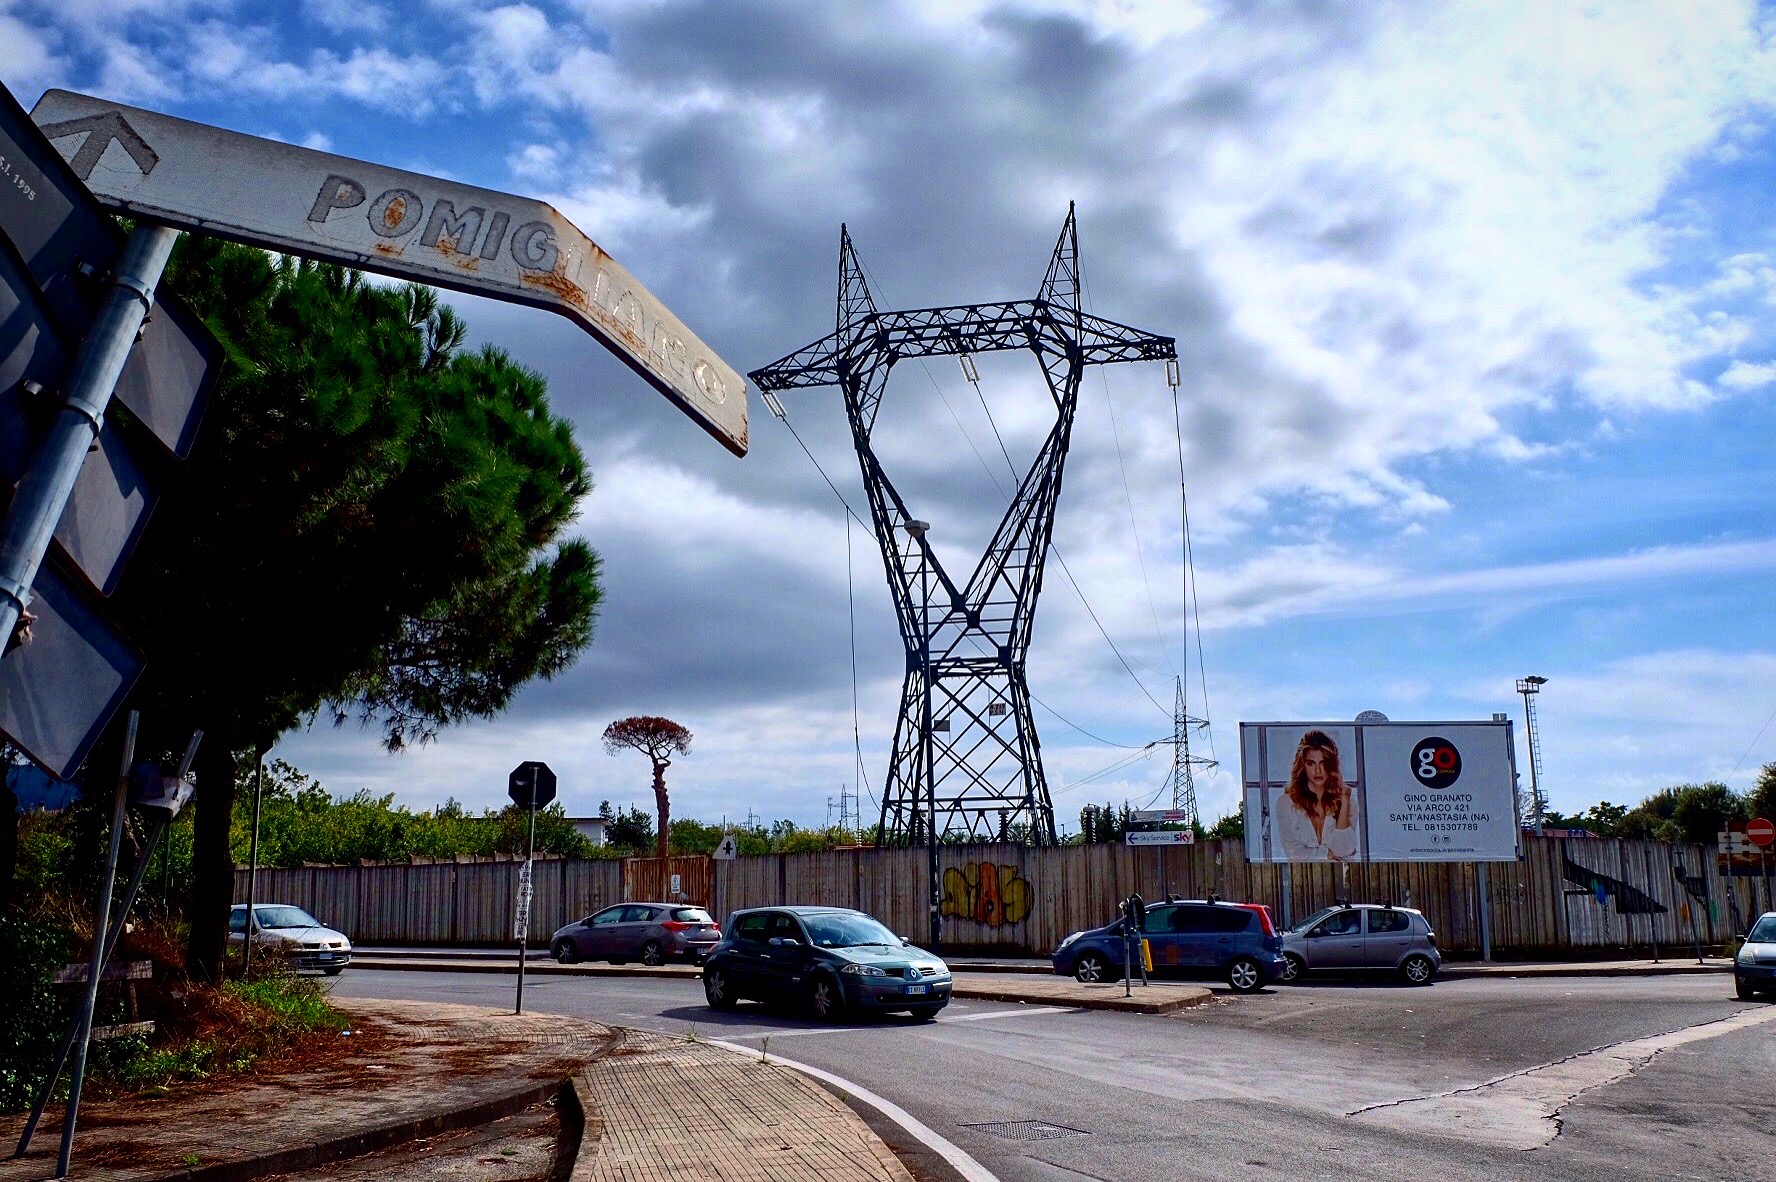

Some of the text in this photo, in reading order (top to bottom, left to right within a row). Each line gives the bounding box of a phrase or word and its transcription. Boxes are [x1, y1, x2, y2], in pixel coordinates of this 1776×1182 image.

[13, 174, 36, 201] 1995
[1404, 794, 1472, 802] GINO GRANATO
[1407, 804, 1422, 812] VIA
[1425, 804, 1451, 812] ARCO
[1389, 813, 1490, 823] SANT'ANASTASIA (NA)
[1402, 823, 1478, 831] TEL. 0815307789
[1173, 832, 1192, 843] sky
